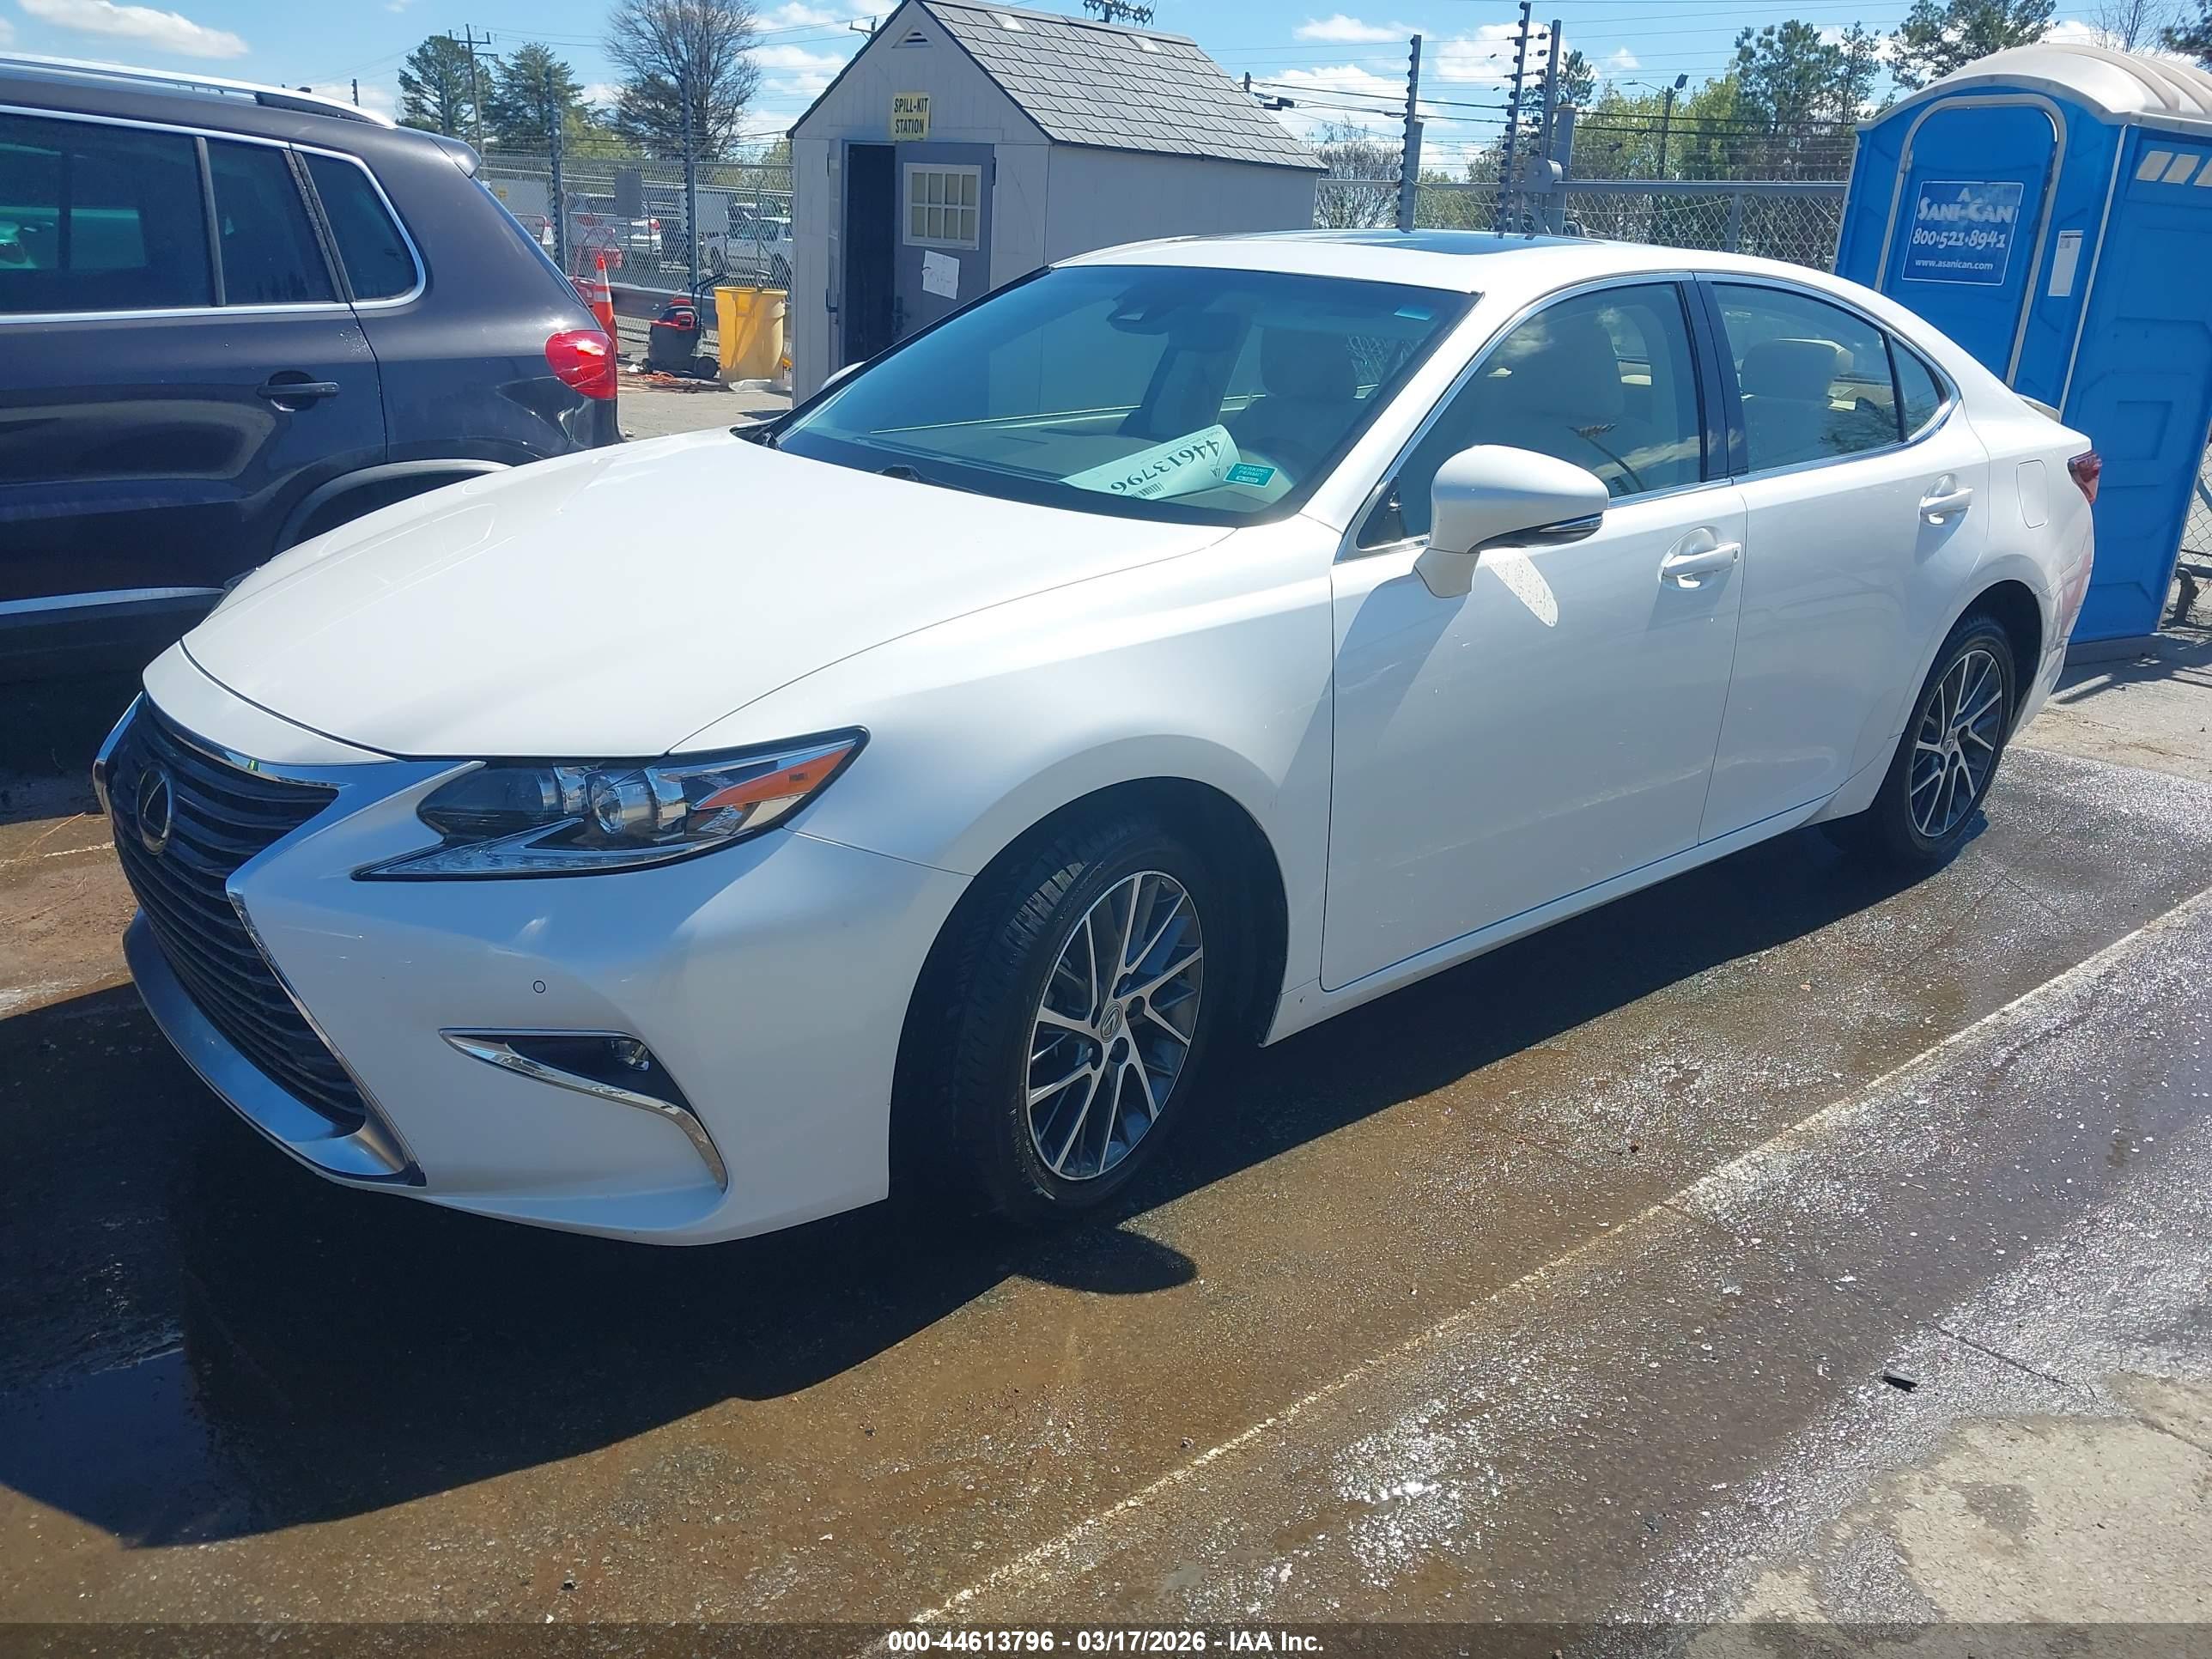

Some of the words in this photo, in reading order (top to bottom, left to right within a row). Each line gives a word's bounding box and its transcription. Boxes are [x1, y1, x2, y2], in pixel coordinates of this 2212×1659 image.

[894, 97, 928, 113] SPILL-KIT
[895, 118, 925, 134] STATION
[1957, 187, 1972, 202] A
[1915, 258, 1994, 270] www.asanican.com
[1110, 440, 1219, 494] 44613796
